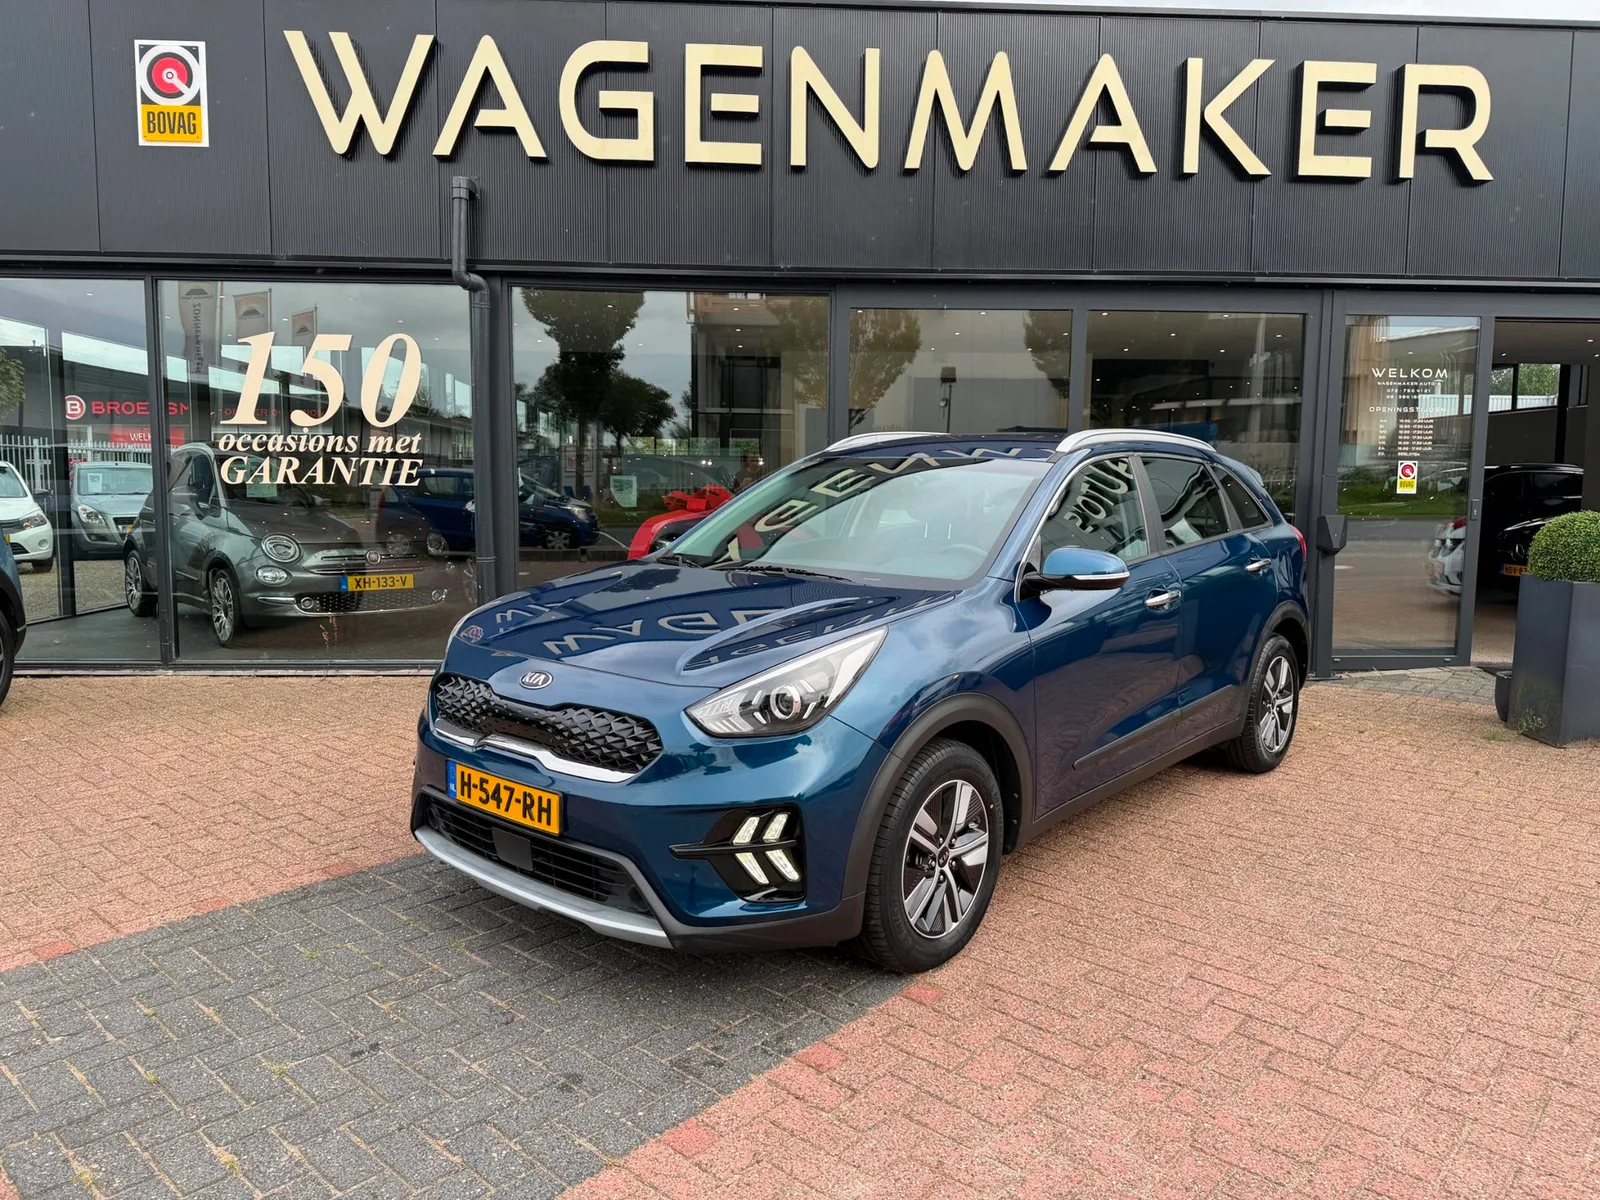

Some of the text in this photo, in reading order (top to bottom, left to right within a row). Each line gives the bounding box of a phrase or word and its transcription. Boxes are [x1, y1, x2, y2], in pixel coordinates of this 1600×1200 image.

[283, 30, 1494, 183] WAGENMAKER
[146, 111, 197, 135] BOVAG
[220, 331, 423, 428] 150
[1371, 368, 1448, 379] WELKOM
[66, 400, 81, 414] B
[218, 427, 422, 454] occasions met
[220, 456, 424, 487] GARANTIE
[1400, 480, 1415, 488] BOVAG
[354, 576, 408, 589] XH-133-V
[521, 671, 547, 687] KIA
[460, 770, 552, 827] H-547-RH
